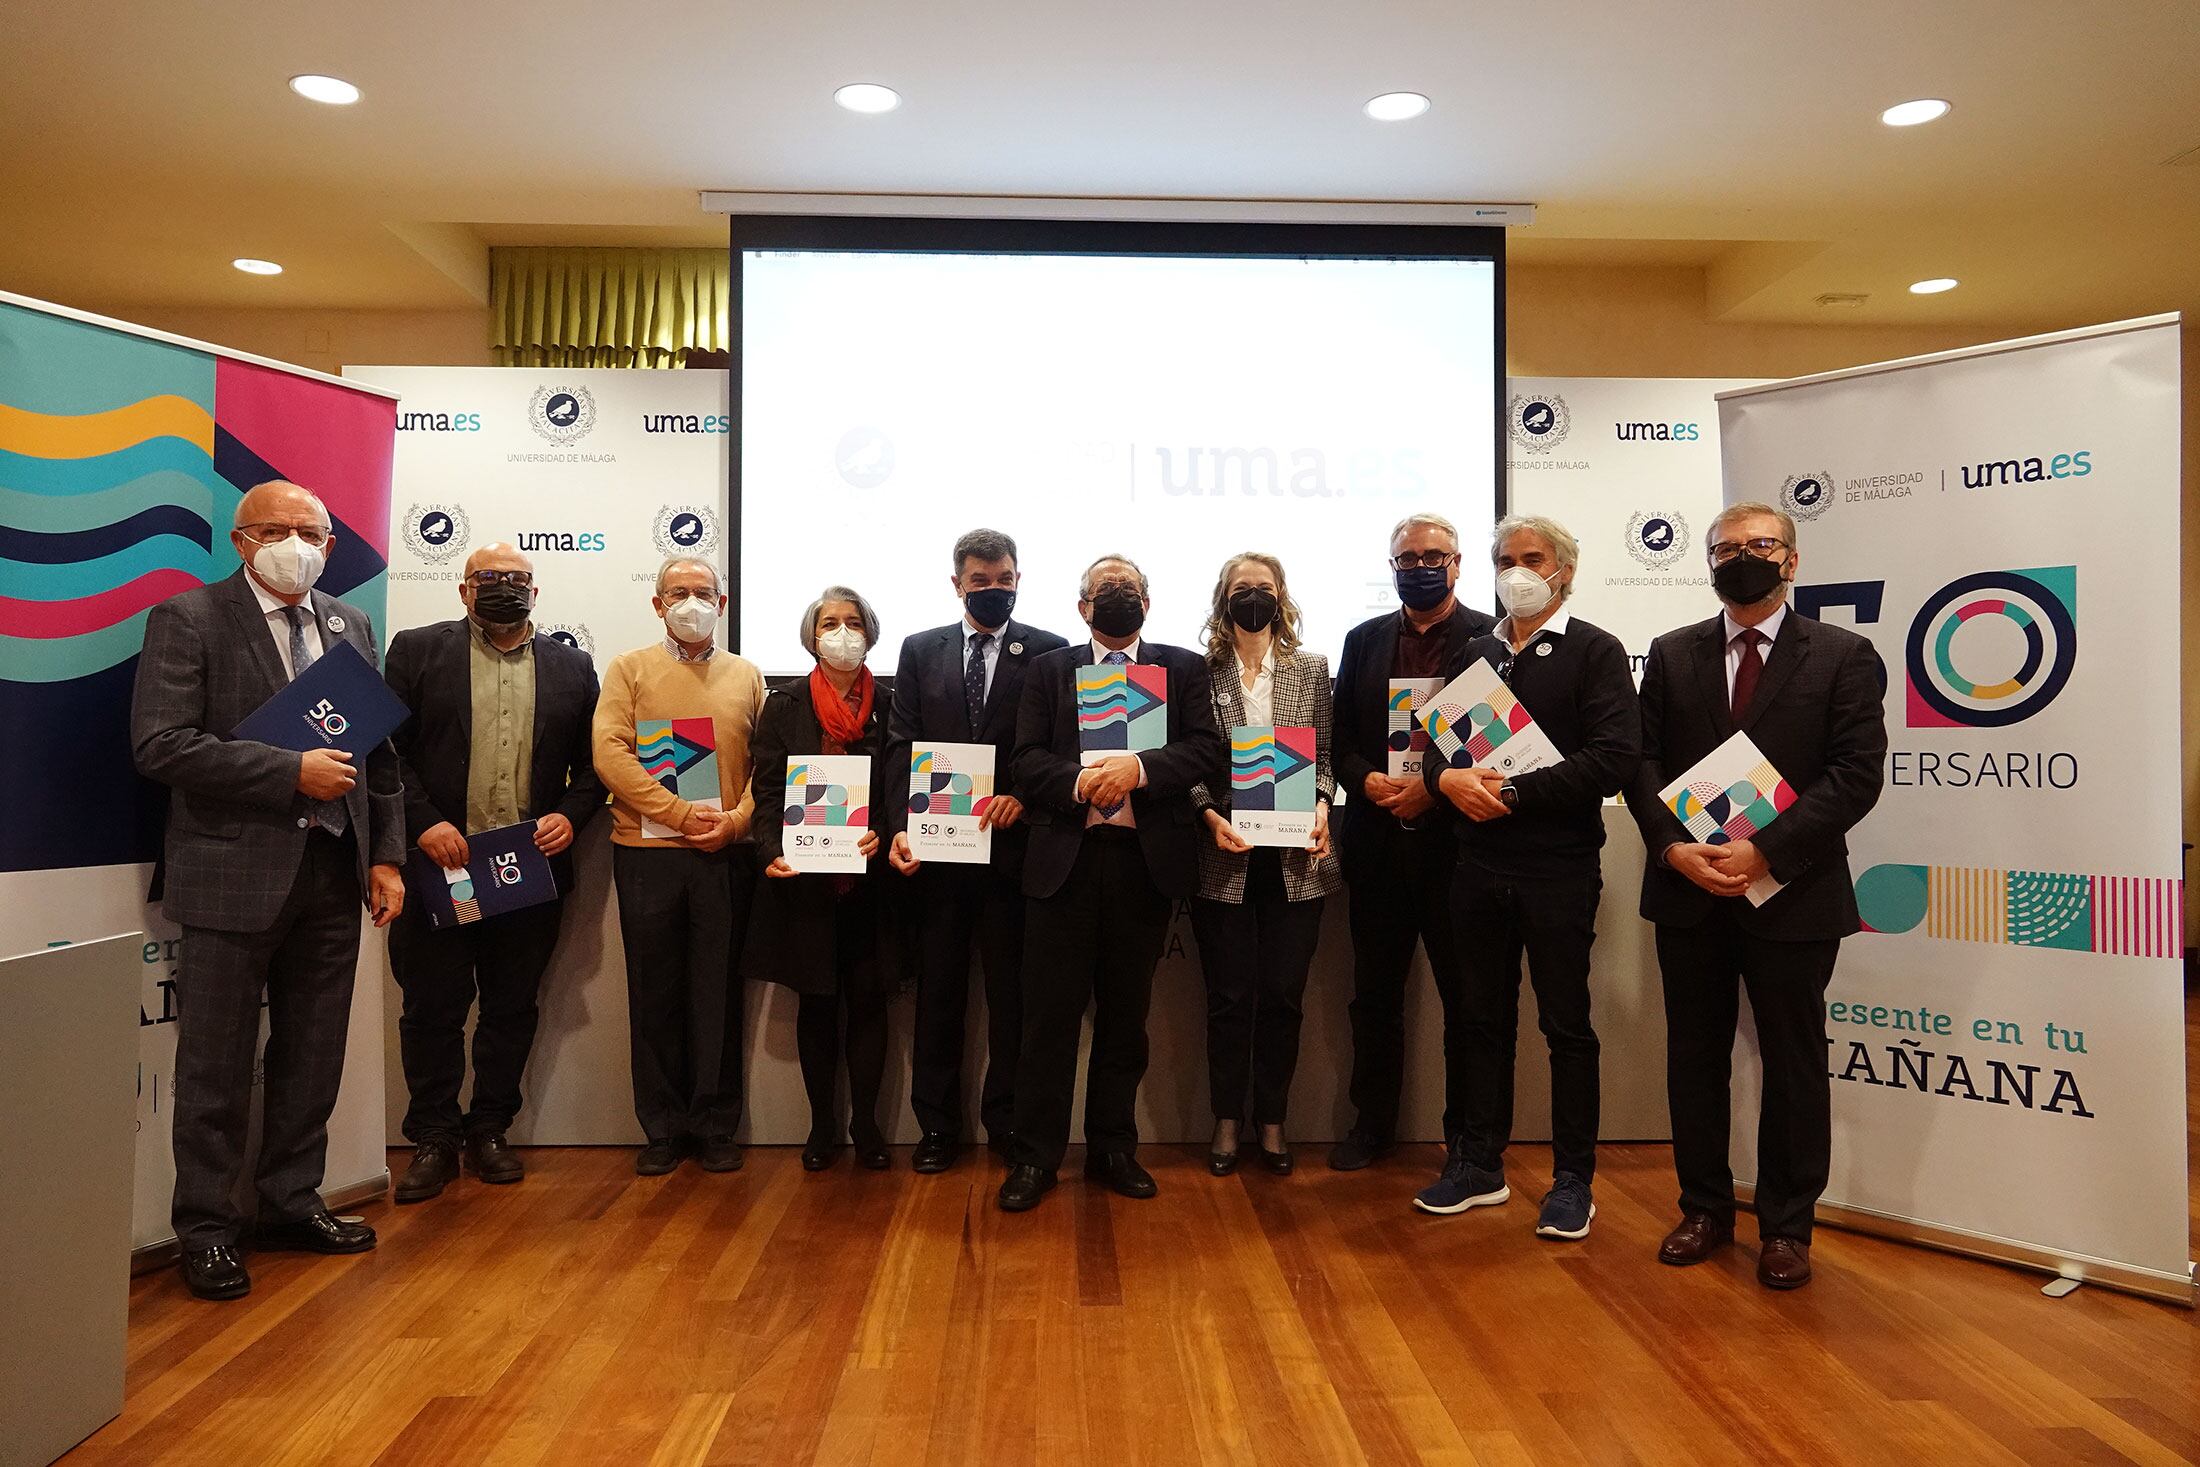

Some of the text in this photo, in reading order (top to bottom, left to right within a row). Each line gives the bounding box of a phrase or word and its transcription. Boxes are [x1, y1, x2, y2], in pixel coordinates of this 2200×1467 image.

[395, 412, 481, 432] uma.es
[643, 414, 730, 434] uma.es
[1615, 422, 1699, 442] uma.es
[507, 453, 565, 463] UNIVERSIDAD
[566, 453, 579, 463] DE
[1542, 460, 1554, 470] DE
[1556, 459, 1590, 470] MÁLAGA
[1961, 449, 2092, 489] uma.es
[1845, 471, 1923, 490] UNIVERSIDAD
[1845, 485, 1912, 502] DE MÁLAGA
[518, 532, 606, 552] uma.es
[440, 572, 453, 581] DE
[1605, 577, 1660, 586] UNIVERSIDAD
[1661, 577, 1673, 586] DE
[309, 698, 349, 736] 50
[303, 714, 333, 744] ANIVERSARIO
[1402, 761, 1422, 773] 50
[1888, 751, 2078, 789] ERSARIO
[921, 823, 939, 836] 50
[1239, 821, 1251, 829] 50
[795, 835, 815, 847] 50
[495, 851, 521, 885] 50
[1825, 1000, 2088, 1055] esente en tu
